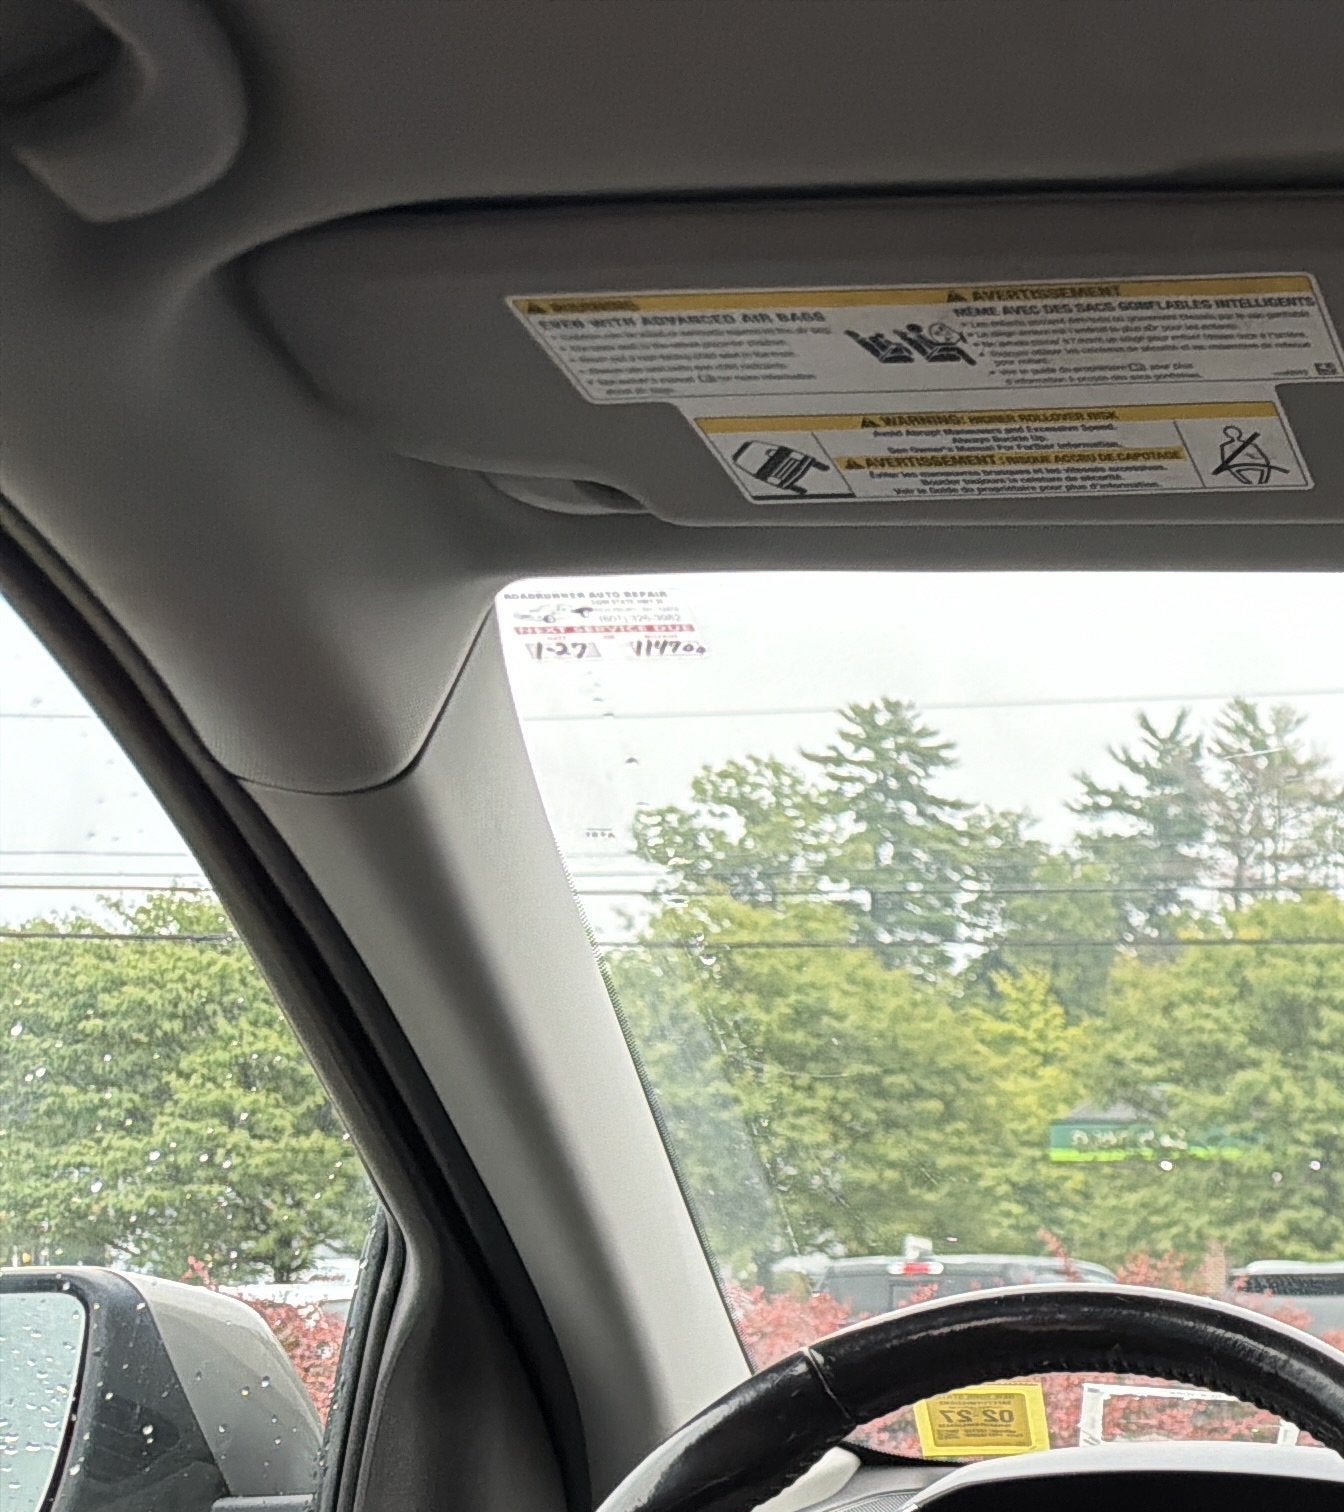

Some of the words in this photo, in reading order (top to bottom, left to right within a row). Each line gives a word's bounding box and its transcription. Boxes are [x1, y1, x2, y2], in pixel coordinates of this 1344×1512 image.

[972, 285, 1121, 301] AVERTISSEMENT
[1002, 305, 1041, 316] AVEC
[1043, 303, 1074, 314] DES
[1075, 302, 1116, 313] SACS
[1215, 296, 1315, 309] INTELLIGENTS
[539, 319, 585, 331] EVEN
[590, 317, 636, 329] WITH
[641, 314, 735, 328] ADVANCED
[741, 312, 774, 324] AIR
[776, 311, 827, 323] BAGS
[865, 455, 996, 470] AVERTISSEMENT
[588, 591, 620, 599] AUTO
[623, 590, 668, 598] REPAIR
